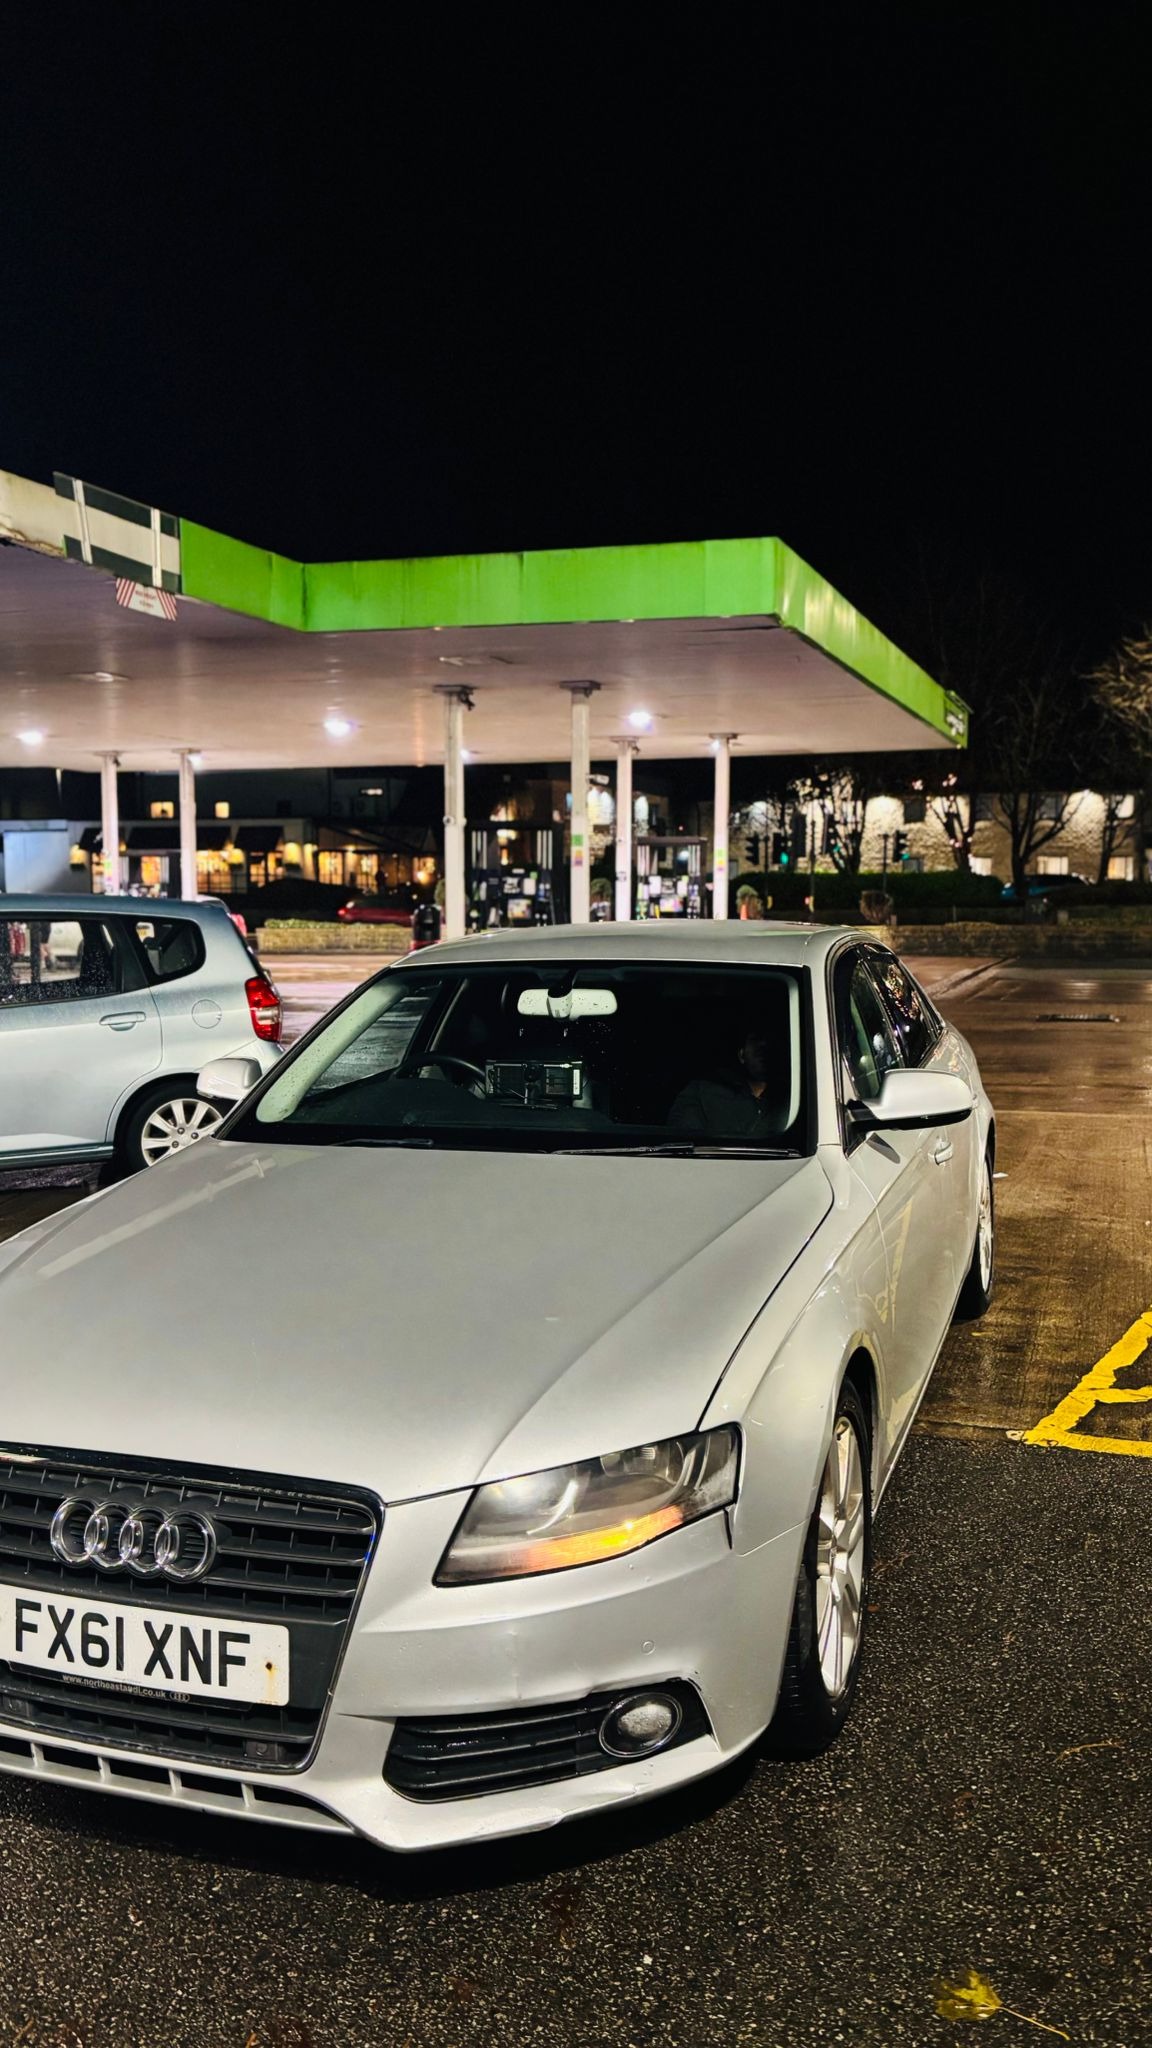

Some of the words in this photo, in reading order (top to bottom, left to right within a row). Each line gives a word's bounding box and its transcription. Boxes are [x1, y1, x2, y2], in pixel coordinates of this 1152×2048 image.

[15, 1598, 125, 1671] FX61
[143, 1620, 251, 1688] XNF
[62, 1674, 166, 1699] www.northeastaudi.co.uk
